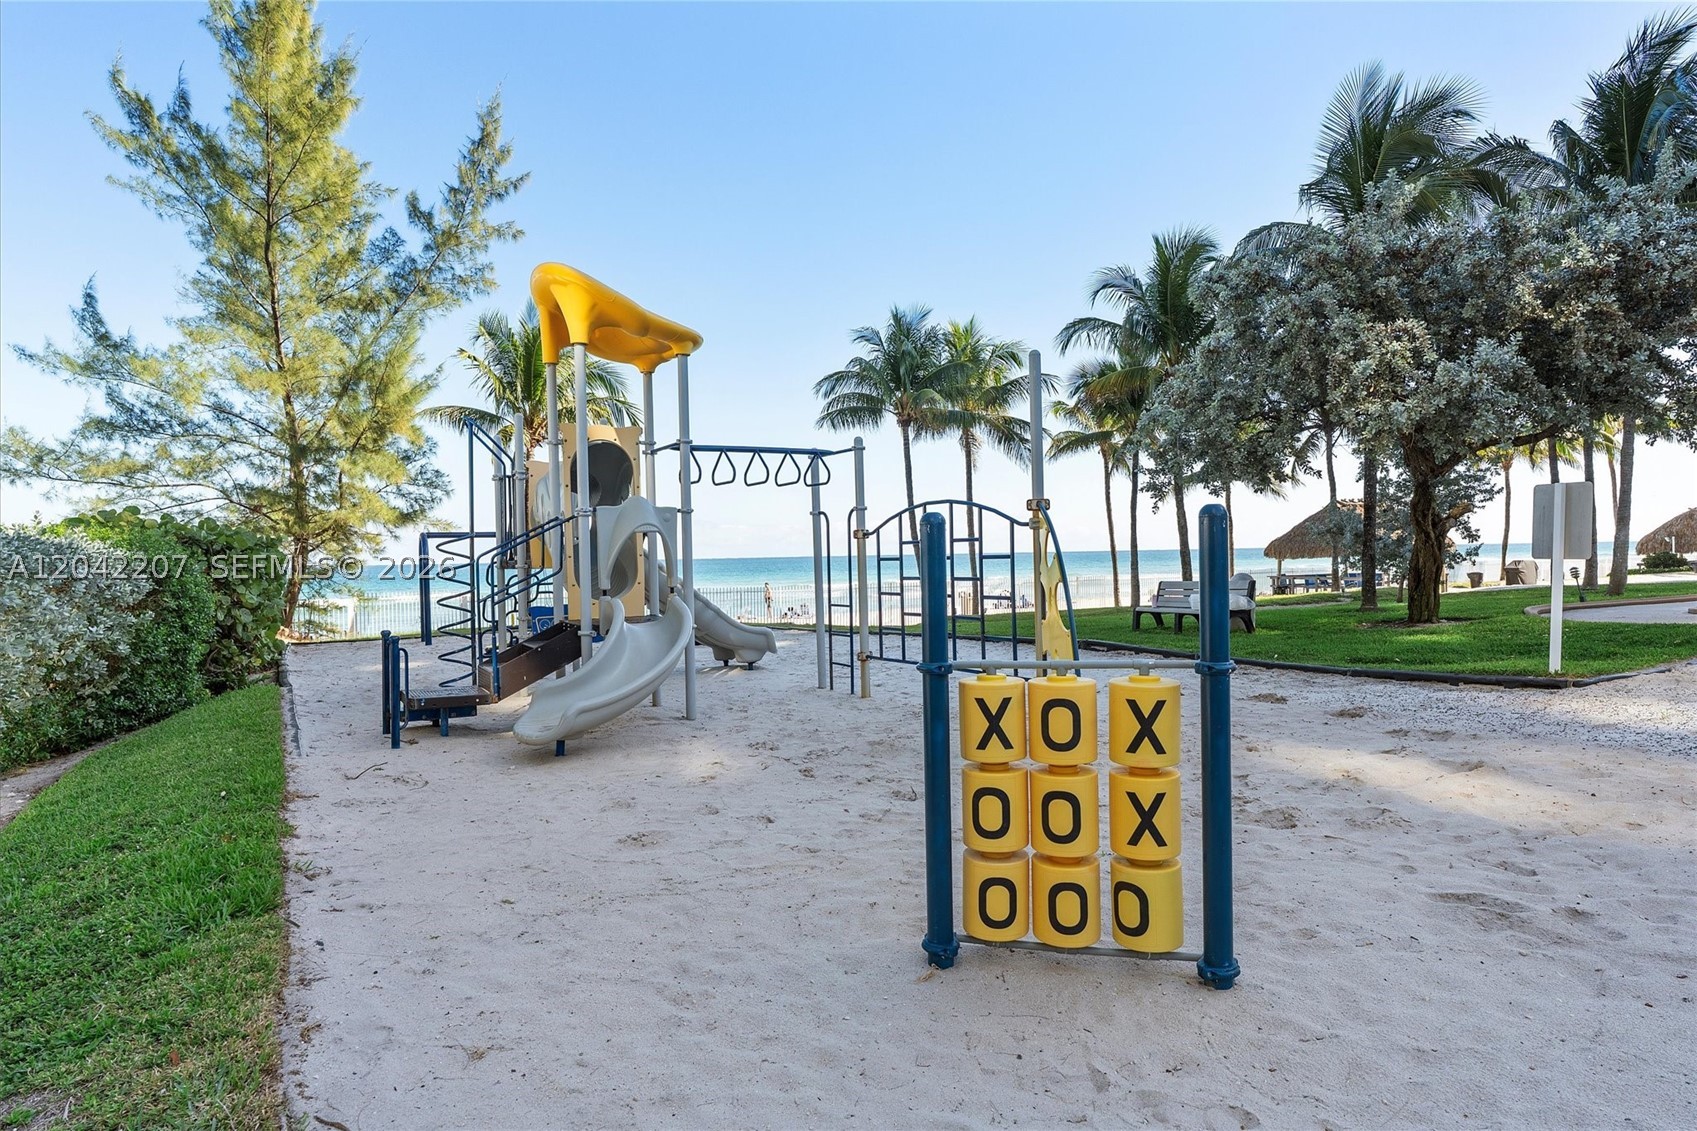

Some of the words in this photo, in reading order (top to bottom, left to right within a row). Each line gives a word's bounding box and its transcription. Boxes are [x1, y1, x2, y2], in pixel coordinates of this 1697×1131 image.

[974, 696, 1014, 750] X
[1041, 698, 1081, 752] O
[1125, 698, 1167, 755] X
[972, 787, 1010, 840] O
[1041, 790, 1081, 844] O
[1126, 791, 1168, 847] X
[978, 877, 1017, 929] O
[1048, 882, 1088, 936] O
